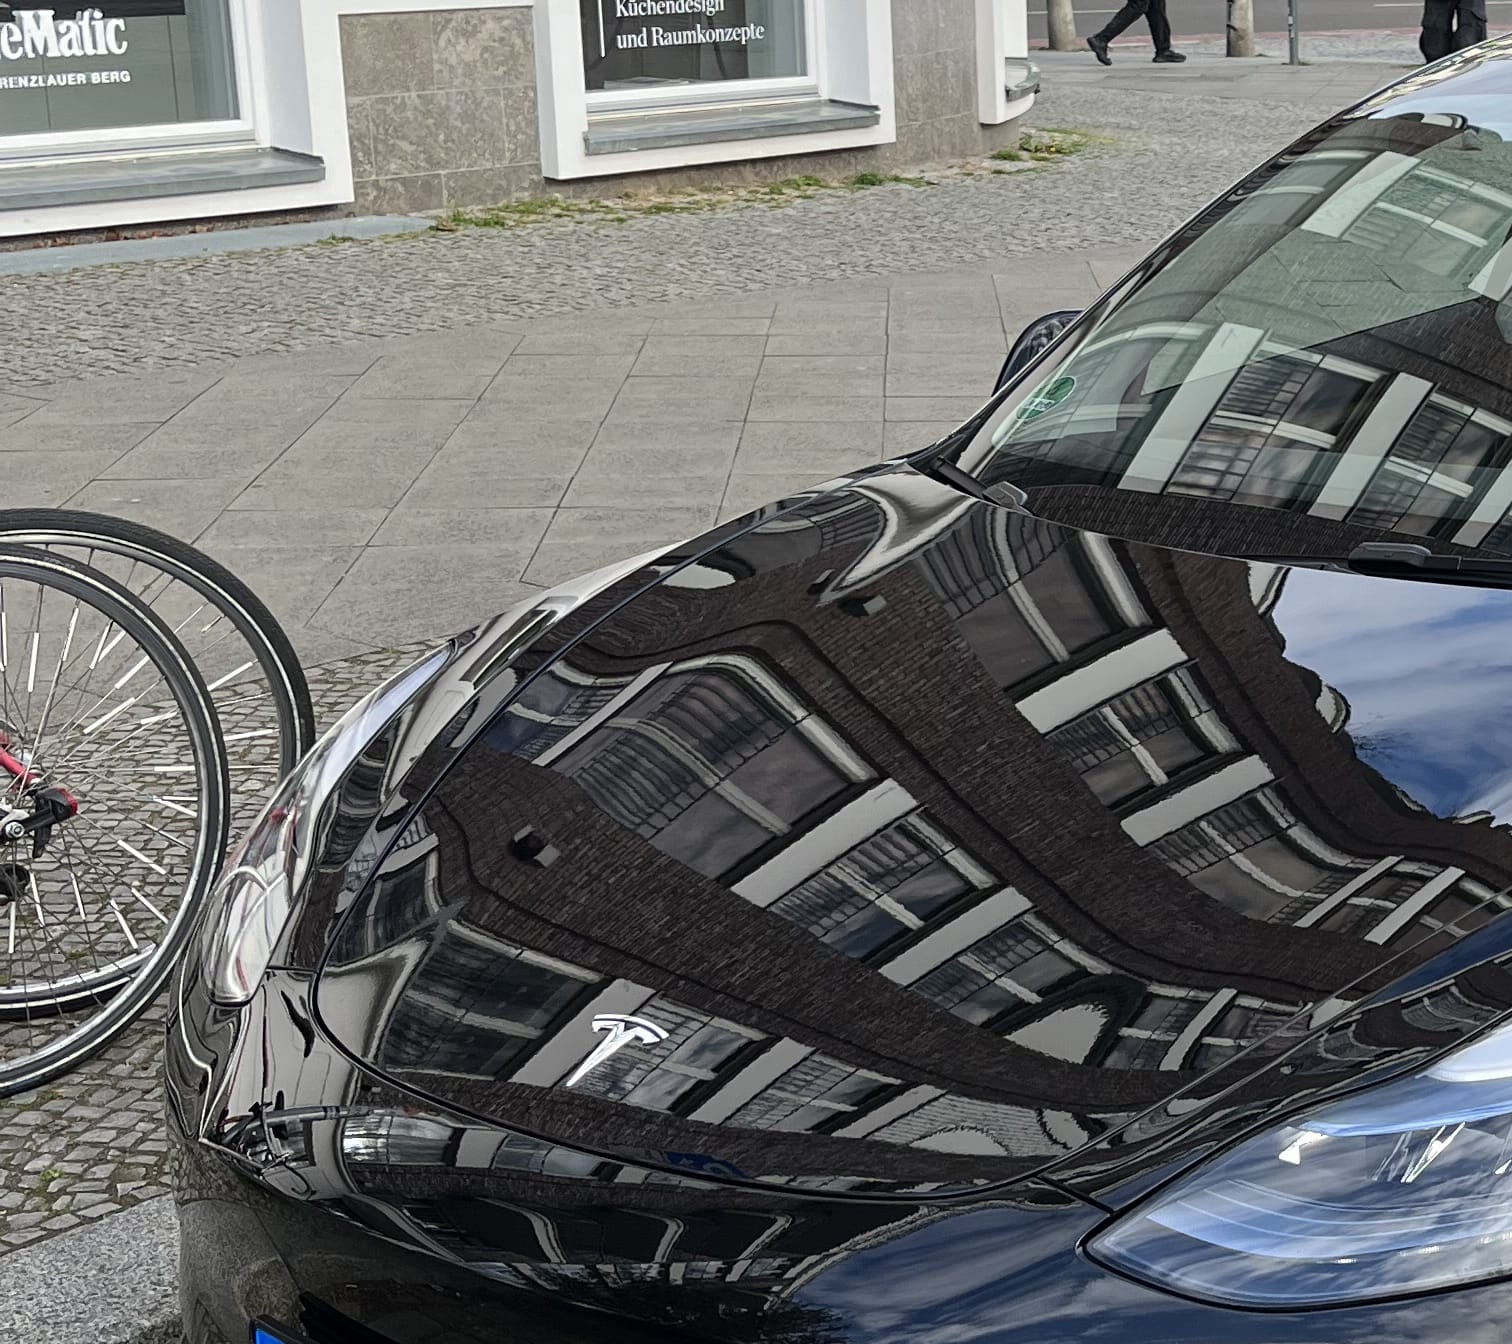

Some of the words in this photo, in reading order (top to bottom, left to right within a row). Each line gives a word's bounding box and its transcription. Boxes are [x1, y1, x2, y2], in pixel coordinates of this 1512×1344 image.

[0, 8, 128, 60] eMatic
[617, 27, 648, 49] und
[651, 23, 765, 47] Raumkonzepte
[91, 70, 131, 85] BERG
